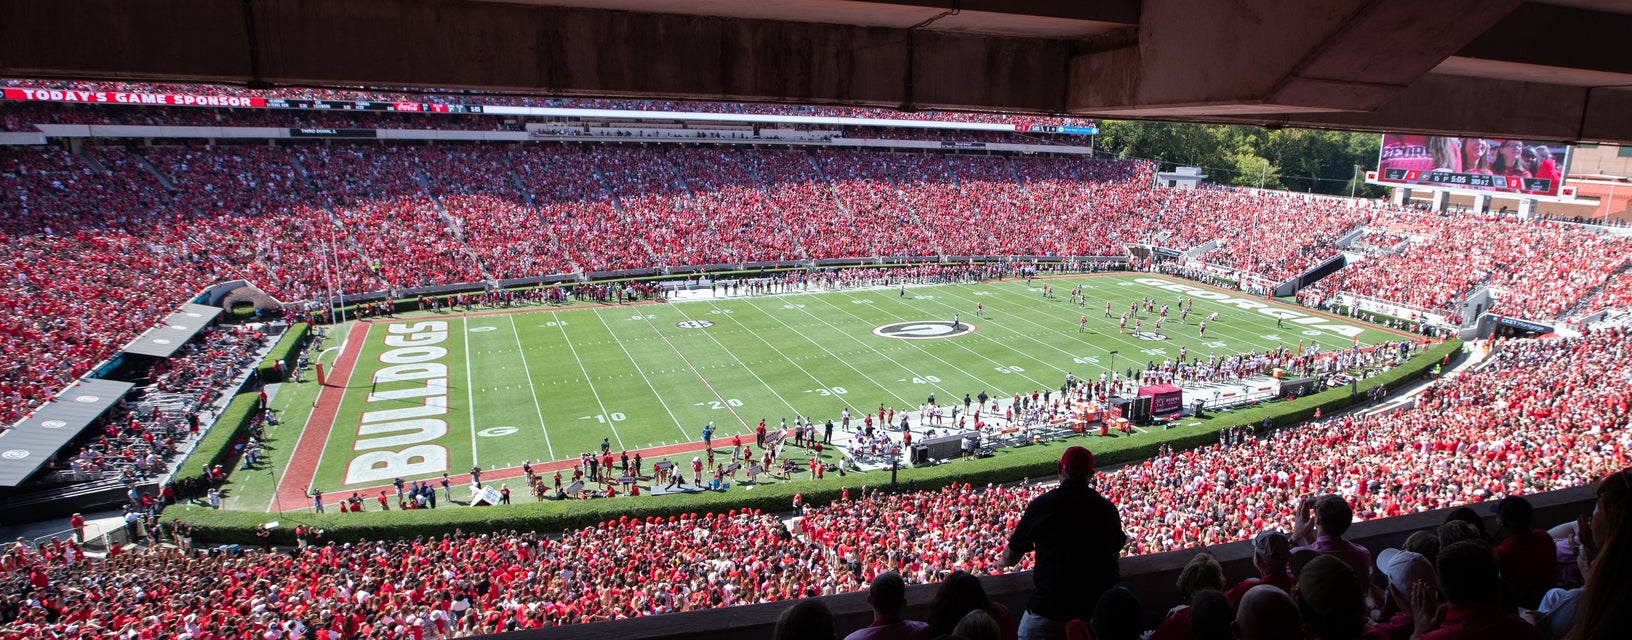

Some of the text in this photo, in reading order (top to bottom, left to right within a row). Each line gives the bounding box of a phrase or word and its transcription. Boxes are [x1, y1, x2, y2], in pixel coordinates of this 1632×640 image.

[23, 89, 252, 107] TODAY'S GAME SPONSOR
[397, 102, 418, 112] Coca-Cola
[1450, 176, 1466, 184] 5:05
[1133, 277, 1366, 338] GEORGIA
[994, 365, 1024, 374] 50
[912, 375, 942, 385] 40
[815, 386, 848, 396] 30
[342, 320, 450, 486] BULLDOGS
[706, 398, 744, 410] 20
[594, 412, 627, 424] 10
